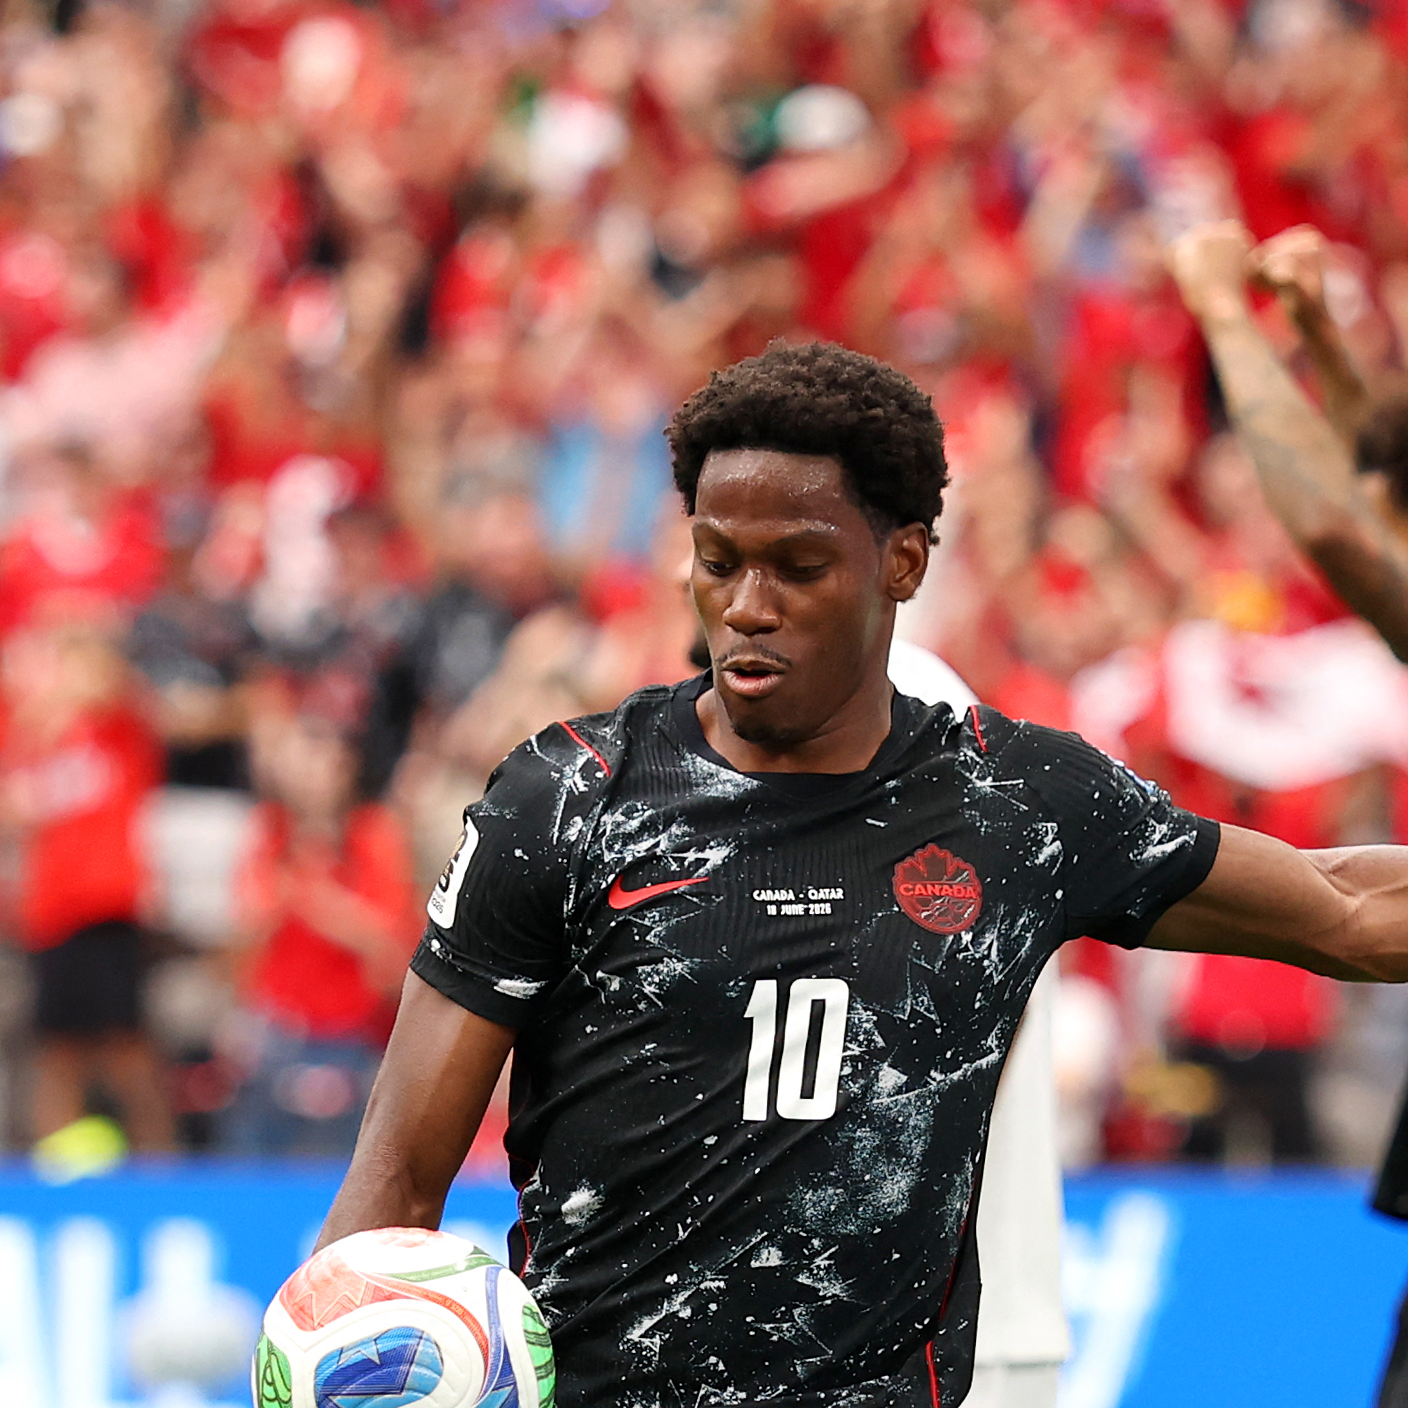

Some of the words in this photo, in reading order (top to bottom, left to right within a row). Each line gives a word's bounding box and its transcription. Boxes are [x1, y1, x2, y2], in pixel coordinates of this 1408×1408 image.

[753, 889, 796, 901] CANADA
[808, 888, 844, 900] QATAR
[898, 883, 977, 899] CANADA
[766, 904, 777, 915] 18
[781, 904, 805, 915] JUNE
[809, 903, 832, 914] 2026
[743, 978, 850, 1122] 10
